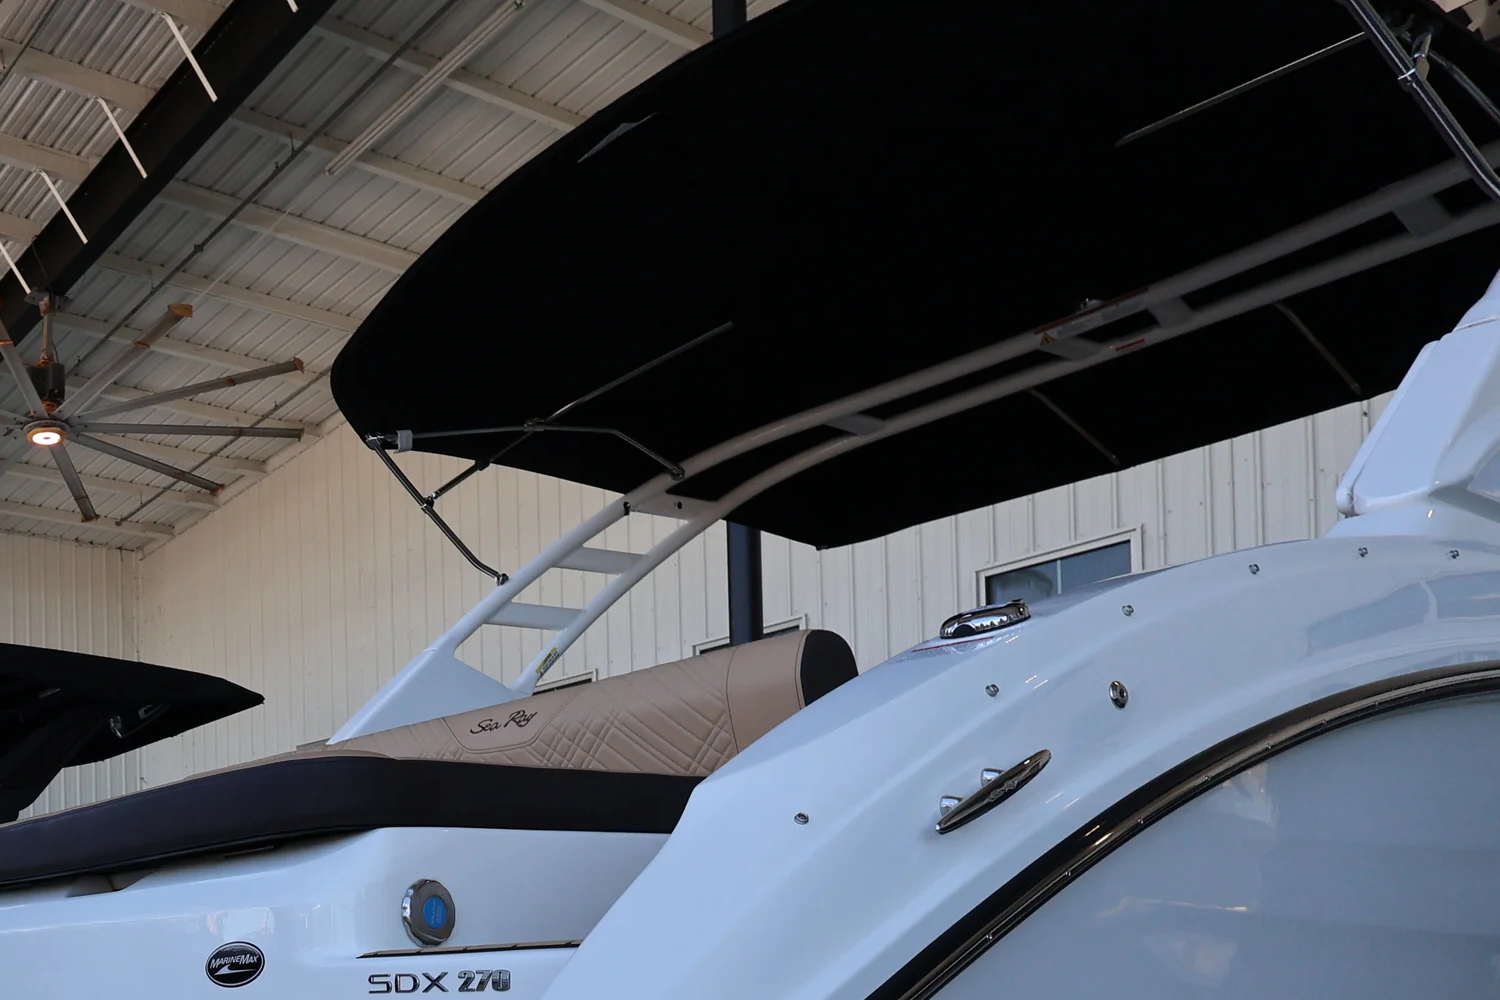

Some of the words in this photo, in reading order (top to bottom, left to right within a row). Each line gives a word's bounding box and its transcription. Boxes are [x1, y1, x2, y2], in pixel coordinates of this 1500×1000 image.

[470, 718, 502, 734] Sea
[503, 710, 538, 728] Ray
[368, 971, 449, 994] SDX
[457, 969, 511, 992] 270
